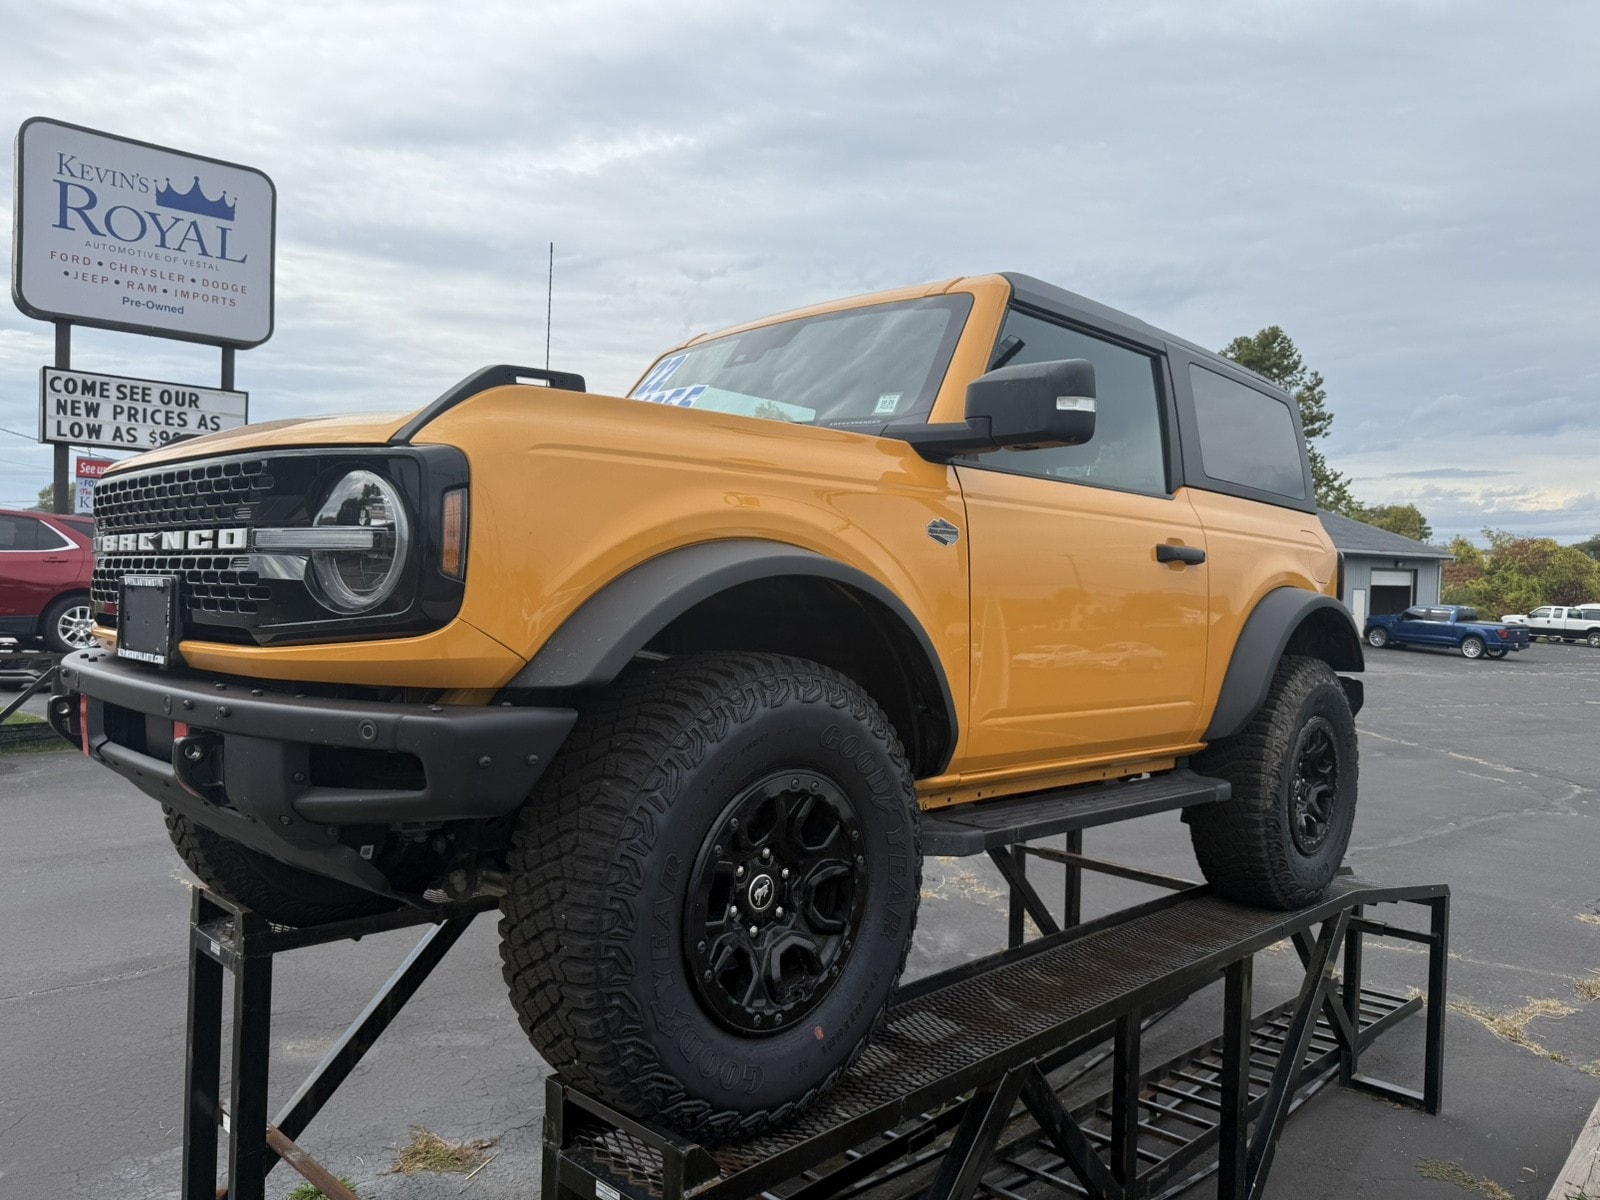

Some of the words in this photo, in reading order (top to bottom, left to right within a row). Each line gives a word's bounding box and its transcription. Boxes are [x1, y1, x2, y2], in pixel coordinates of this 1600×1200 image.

[57, 152, 150, 193] KEVIN'S
[51, 179, 248, 264] ROYAL
[85, 240, 161, 262] AUTOMOTIVE
[165, 255, 180, 264] OF
[183, 258, 221, 272] VESTAL
[50, 251, 92, 267] FORD
[109, 261, 187, 284] CHRYSLER
[202, 278, 249, 295] DODGE
[73, 271, 110, 285] JEEP
[126, 280, 158, 294] RAM
[174, 289, 238, 308] IMPORTS
[122, 296, 185, 315] Pre-Owned
[49, 376, 110, 399] COME
[116, 384, 152, 404] SEE
[159, 389, 200, 409] OUR
[634, 355, 687, 397] 22
[56, 399, 101, 418] NEW
[112, 405, 188, 428] PRICES
[197, 415, 221, 432] AS
[56, 421, 102, 440] LOW
[112, 427, 138, 443] AS
[80, 462, 96, 474] See
[102, 528, 248, 551] BRONCO
